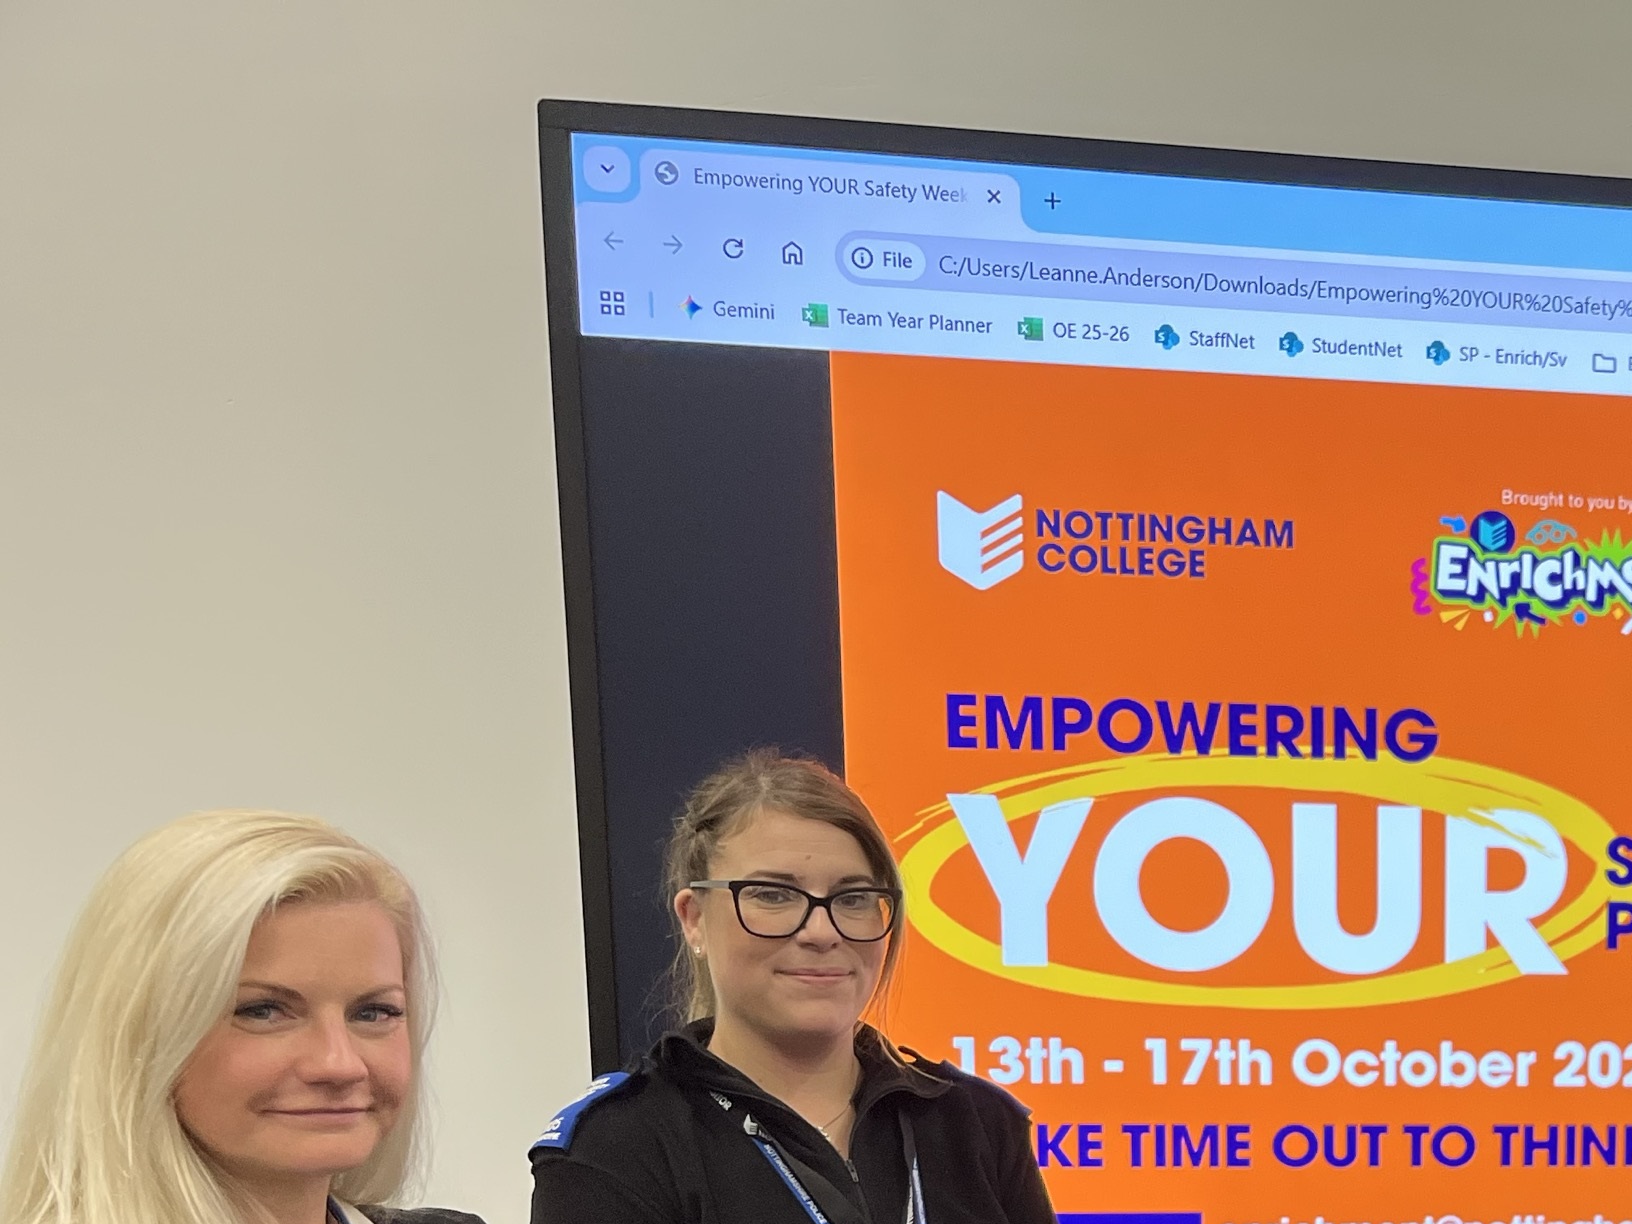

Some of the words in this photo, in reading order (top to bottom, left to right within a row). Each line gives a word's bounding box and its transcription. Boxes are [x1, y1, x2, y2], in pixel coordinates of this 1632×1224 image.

[694, 168, 803, 195] Empowering
[808, 176, 860, 195] YOUR
[864, 180, 917, 203] Safety
[921, 184, 968, 203] Week
[883, 251, 913, 269] File
[713, 300, 775, 320] Gemini
[837, 308, 882, 327] Team
[888, 311, 924, 330] Year
[929, 314, 993, 334] Planner
[1053, 322, 1077, 339] OE
[1082, 323, 1130, 342] 25-26
[1190, 331, 1256, 350] StaffNet
[1312, 338, 1403, 358] StudentNet
[1459, 346, 1479, 362] SP
[1496, 348, 1567, 368] Enrich/Sv
[1501, 489, 1564, 510] Brought
[1568, 494, 1583, 509] to
[1587, 497, 1615, 512] you
[1035, 508, 1294, 549] NOTTINGHAM
[1036, 543, 1206, 578] COLLEGE
[945, 692, 1439, 763] EMPOWERING
[945, 792, 1570, 976] YOUR
[952, 1035, 1085, 1086] 13th
[1145, 1037, 1274, 1086] 17th
[1292, 1037, 1537, 1088] October
[1037, 1124, 1103, 1167] KE
[1121, 1124, 1251, 1167] TIME
[1272, 1124, 1388, 1168] OUT
[1402, 1124, 1476, 1168] TO
[807, 1200, 828, 1224] POLICE
